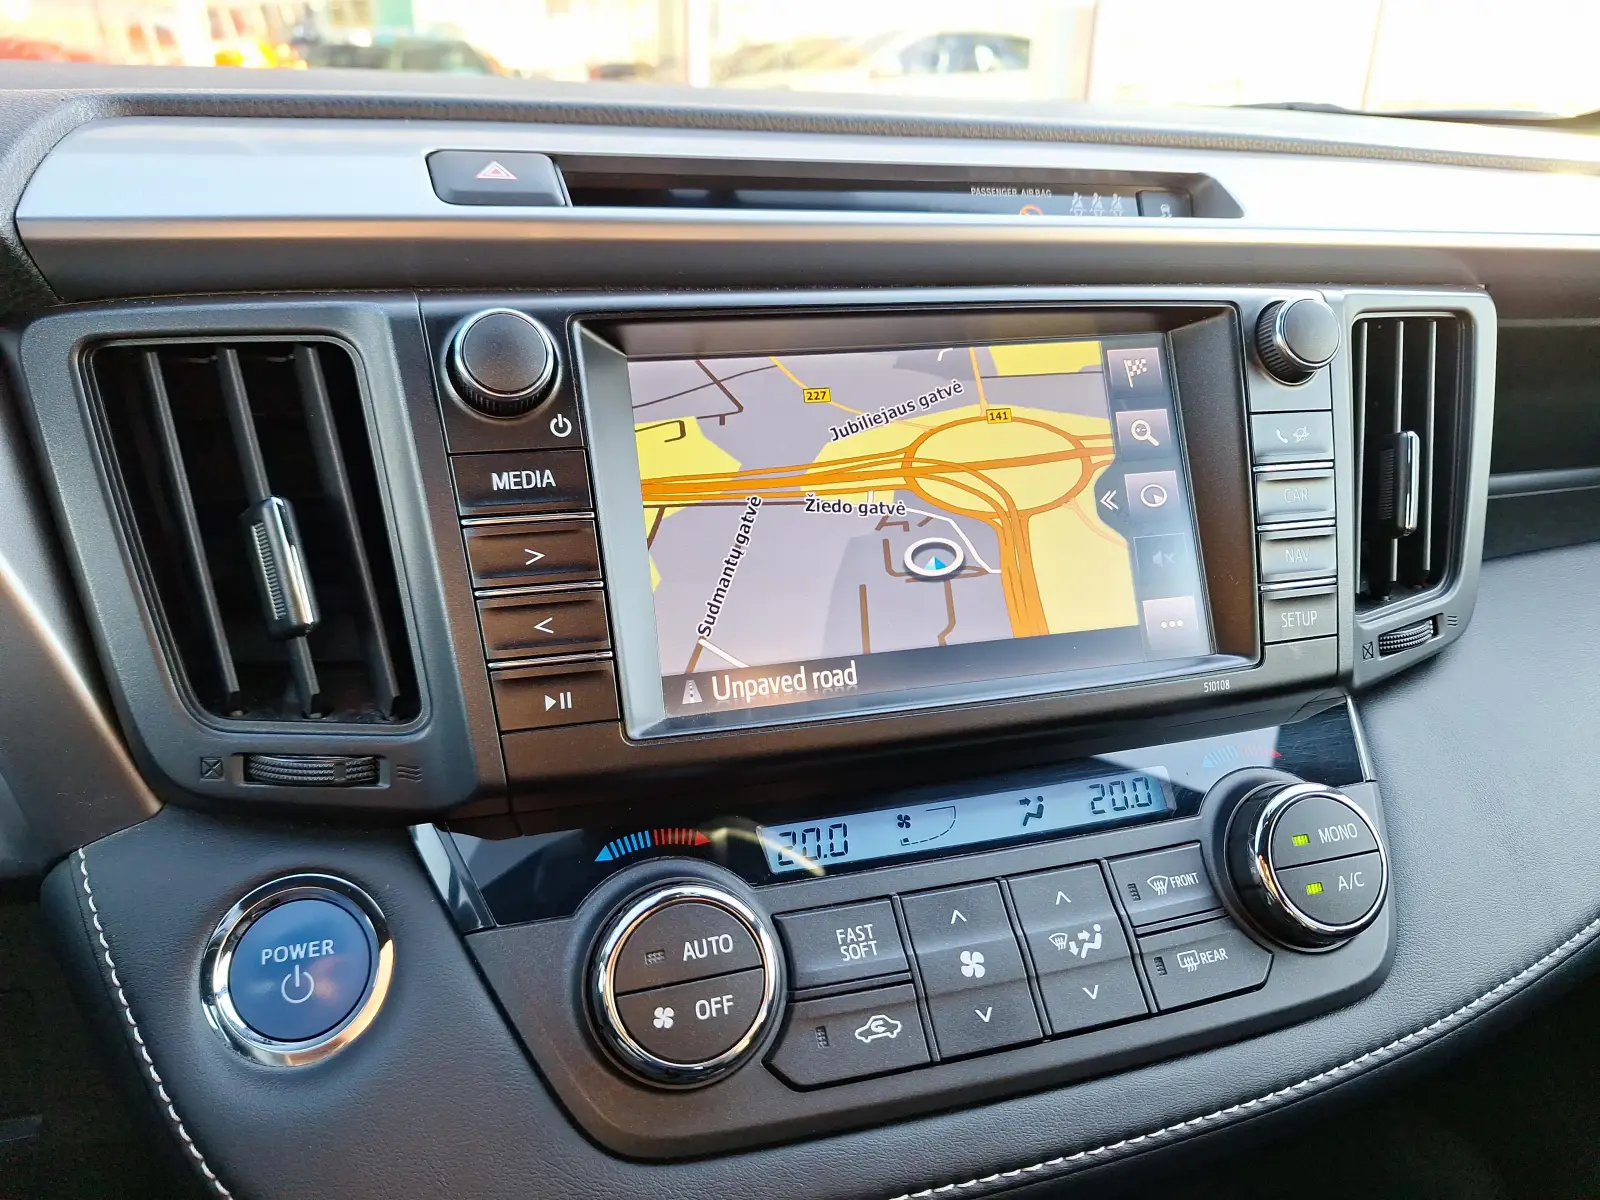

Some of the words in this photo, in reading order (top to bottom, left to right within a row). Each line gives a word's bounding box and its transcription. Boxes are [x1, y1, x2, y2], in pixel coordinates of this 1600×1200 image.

[970, 187, 1017, 197] PASSENGER
[806, 391, 827, 401] 227
[829, 398, 916, 442] Jubiliejaus
[916, 379, 964, 411] gatvė
[989, 411, 1008, 421] 141
[492, 470, 556, 490] MEDIA
[1284, 487, 1309, 502] CAR
[804, 493, 853, 514] Žiedo
[857, 500, 906, 517] gatvė
[1285, 547, 1311, 563] NAV
[697, 547, 744, 637] Sudmantų
[736, 495, 763, 547] gatvė
[1281, 611, 1318, 627] SETUP
[711, 665, 807, 704] Unpaved
[812, 660, 858, 688] road
[1203, 680, 1231, 692] 510108
[1089, 776, 1152, 814] 20.0
[1318, 823, 1358, 844] MONO
[777, 822, 848, 866] 20.0
[1169, 871, 1200, 888] FRONT
[1338, 872, 1365, 890] A/C
[835, 923, 874, 943] FAST
[261, 939, 335, 964] POWER
[683, 933, 734, 961] AUTO
[840, 942, 878, 961] SOFT
[1200, 948, 1228, 964] REAR
[695, 995, 734, 1020] OFF
